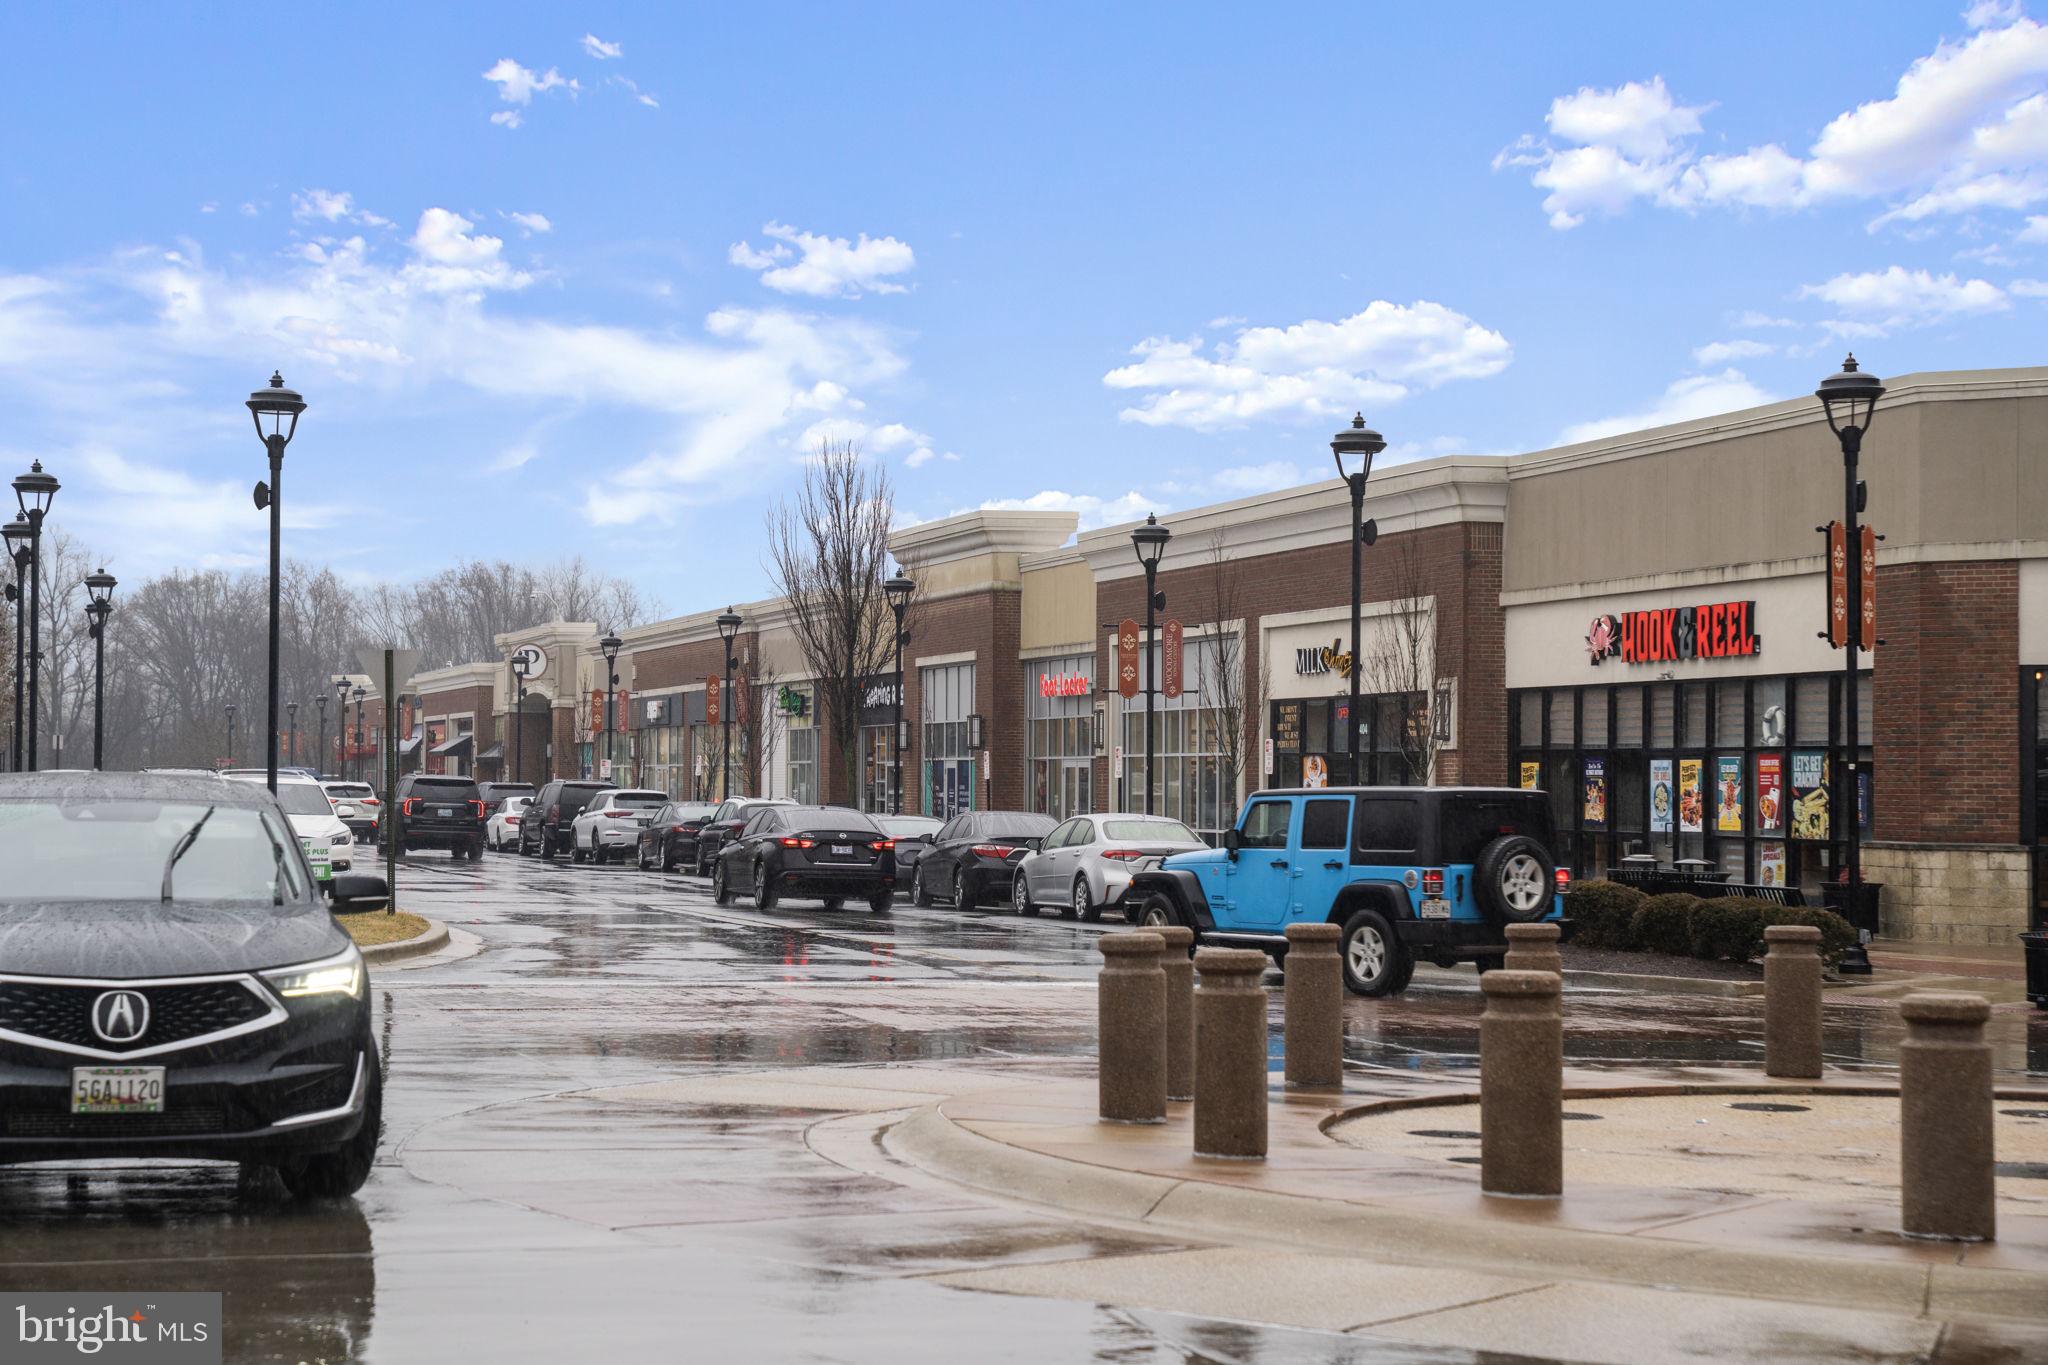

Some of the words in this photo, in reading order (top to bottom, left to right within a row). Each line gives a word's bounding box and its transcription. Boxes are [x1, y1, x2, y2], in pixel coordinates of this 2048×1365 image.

[1621, 608, 1677, 664] HOOK
[1679, 606, 1697, 661] &
[1696, 600, 1756, 659] REEL
[1165, 633, 1173, 685] WOODMORE
[1295, 646, 1328, 674] MILK
[1040, 673, 1057, 697] Foot
[1060, 671, 1089, 697] Locker
[1793, 755, 1810, 772] LET'S
[1810, 755, 1822, 772] GET
